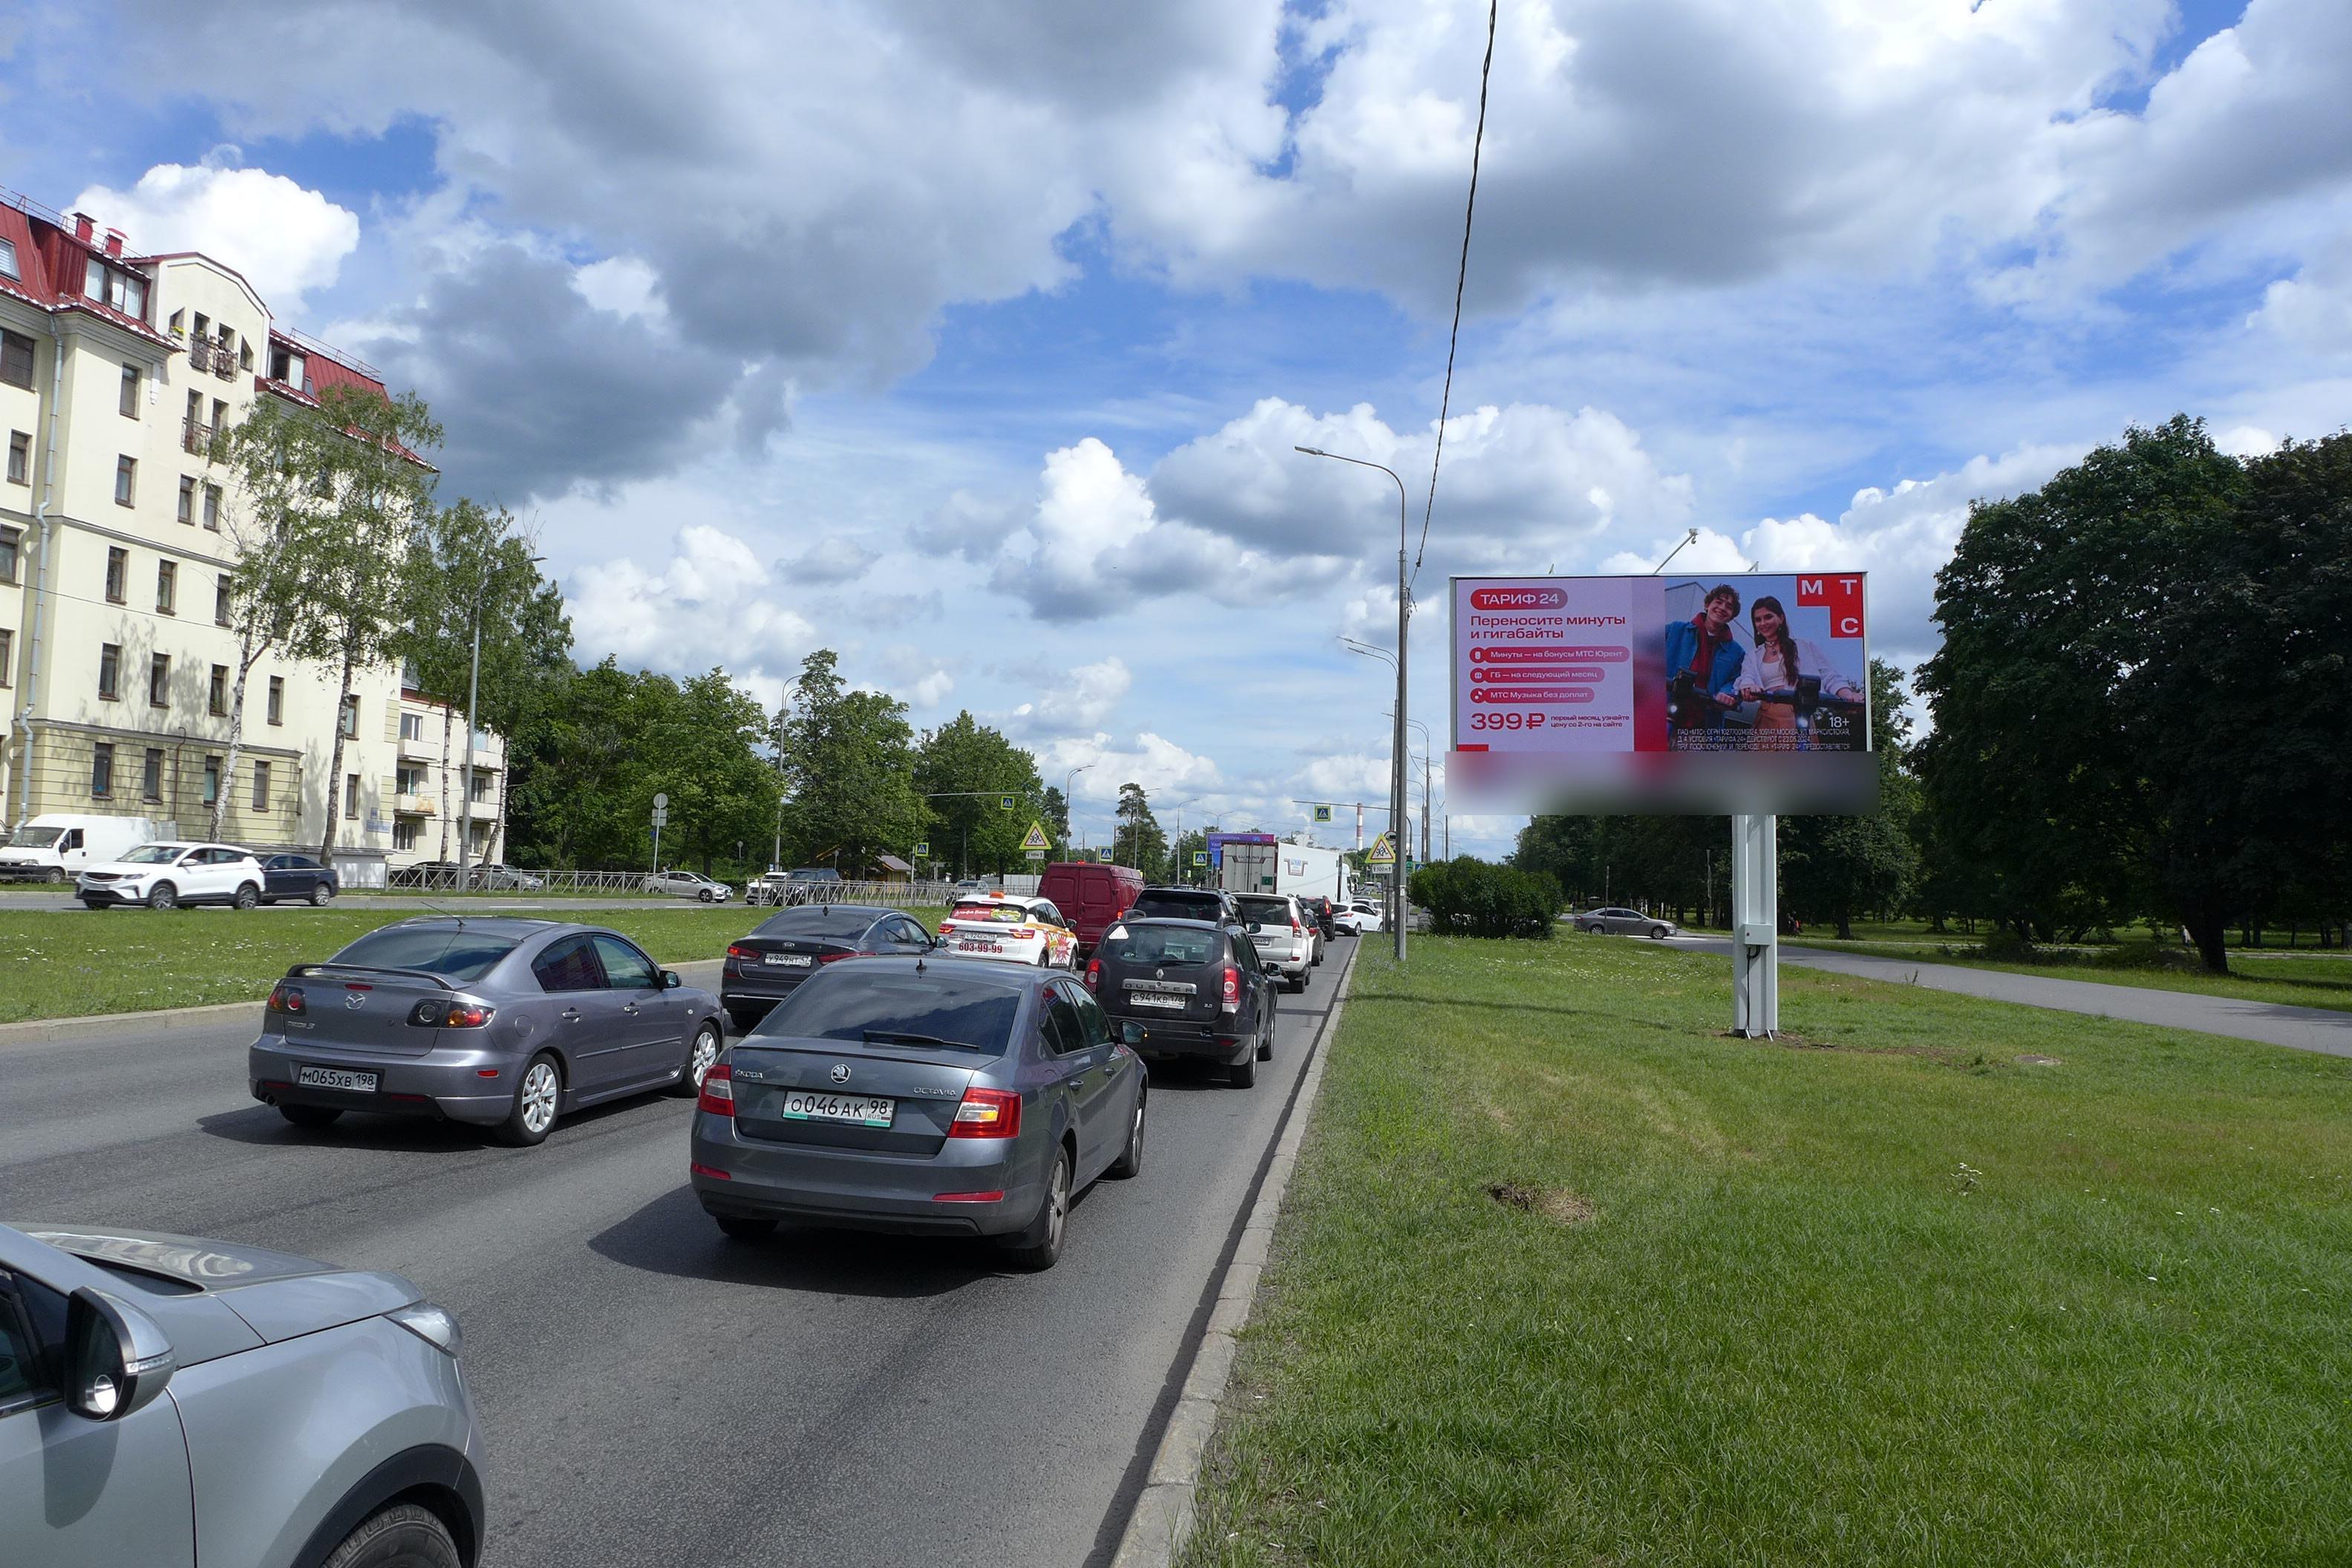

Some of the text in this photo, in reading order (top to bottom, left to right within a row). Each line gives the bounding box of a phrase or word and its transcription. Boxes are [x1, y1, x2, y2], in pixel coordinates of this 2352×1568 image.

[1480, 593, 1559, 605] ТАРИФ 24
[1471, 615, 1626, 628] Переносите минуты
[1471, 628, 1564, 638] и гигабайты
[1490, 651, 1523, 659] Минуты
[1544, 650, 1575, 659] бонусы
[1595, 650, 1623, 659] Юрент
[1471, 713, 1523, 731] 399
[1829, 716, 1850, 728] 18+
[959, 942, 1003, 954] 603-99-99
[1125, 983, 1193, 993] DUSTER
[913, 1087, 956, 1097] OCTAVIA
